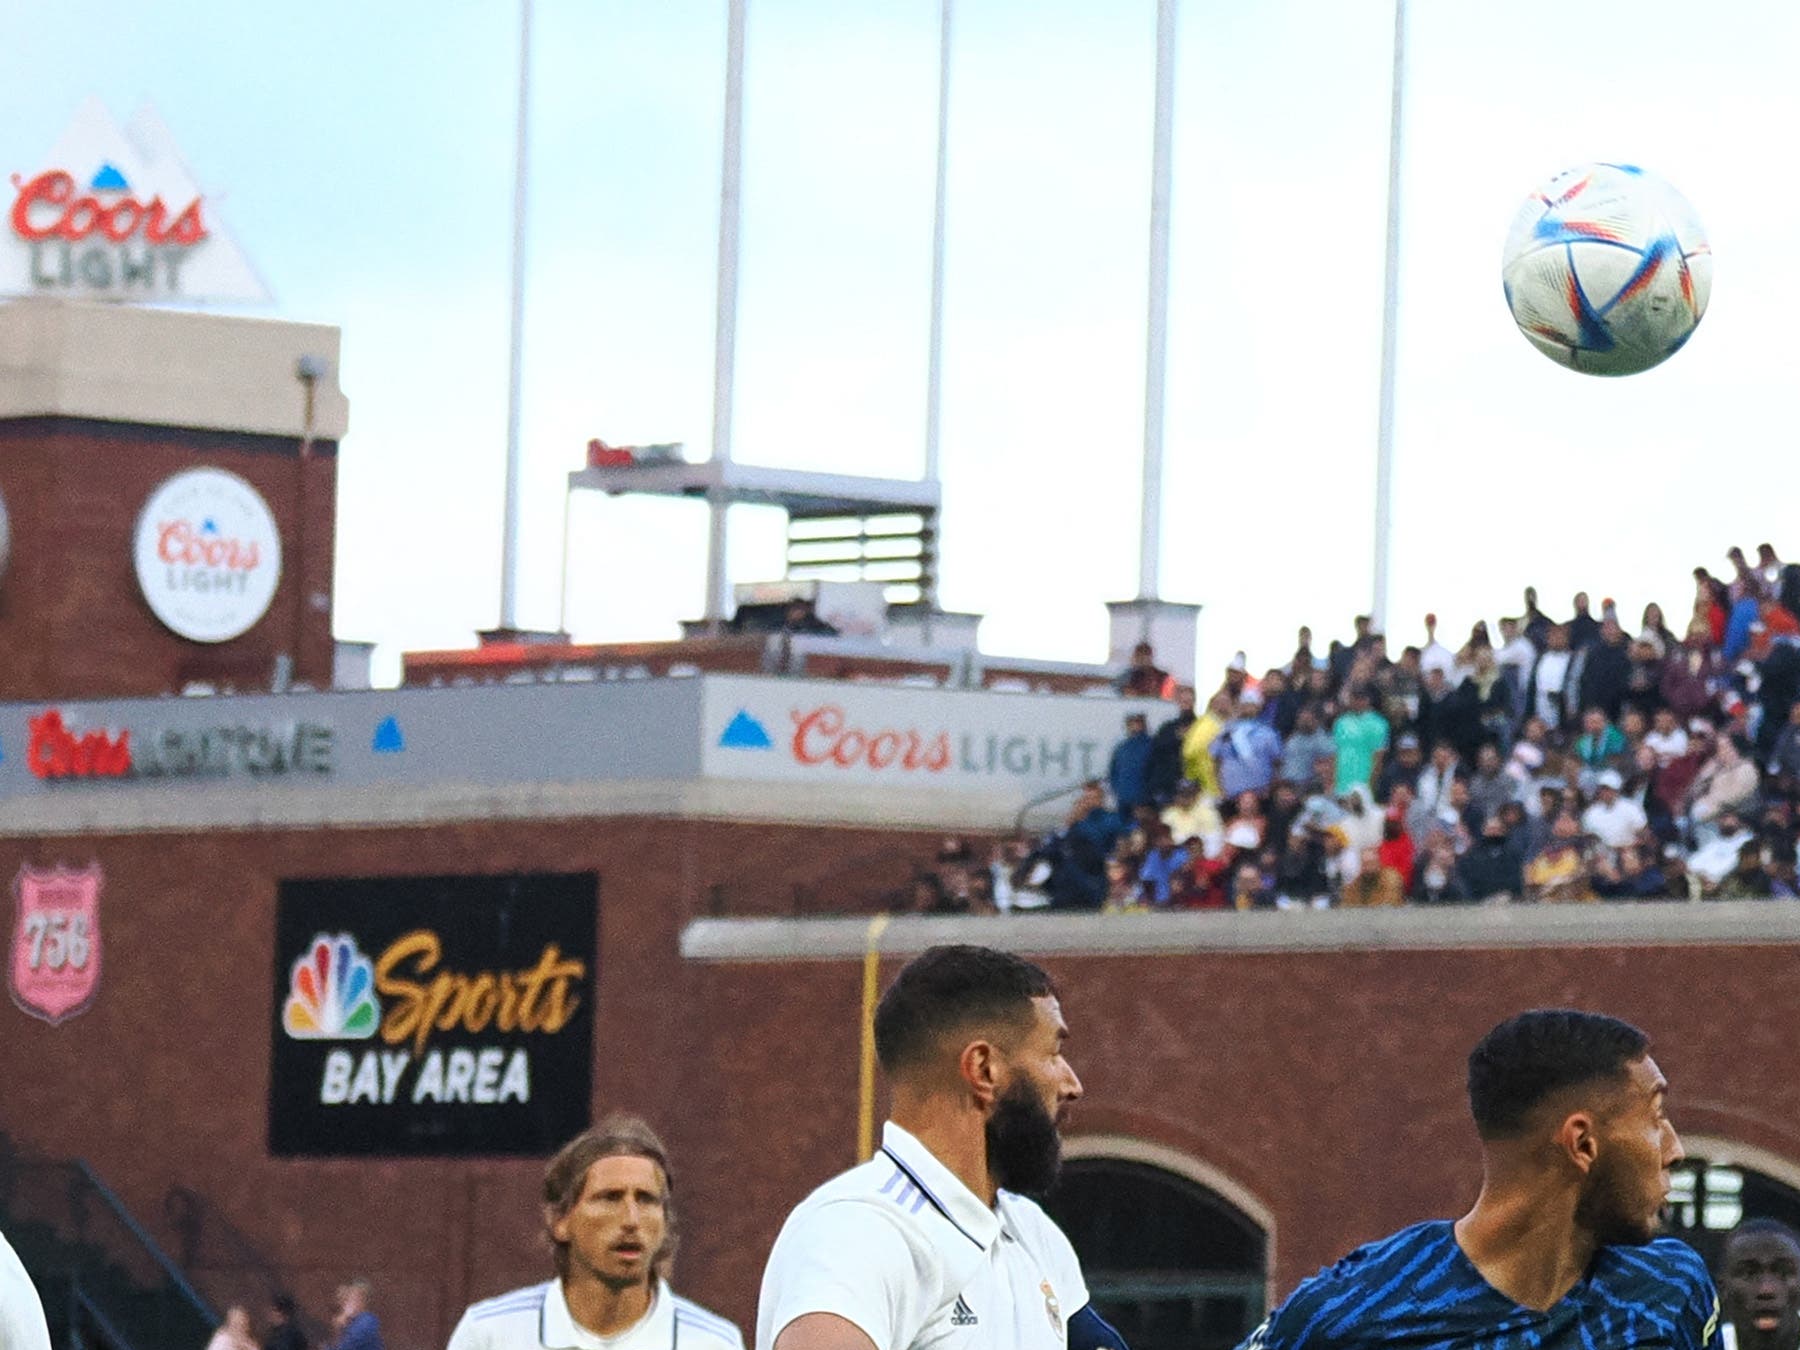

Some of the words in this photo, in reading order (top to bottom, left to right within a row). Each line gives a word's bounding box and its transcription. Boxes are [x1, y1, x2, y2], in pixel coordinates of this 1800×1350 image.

[10, 168, 208, 244] Coors
[28, 243, 189, 291] LIGHT
[157, 519, 261, 571] Coors
[789, 704, 952, 773] Coors
[957, 731, 1100, 778] LIGHT
[25, 912, 90, 969] 756
[375, 928, 586, 1059] Sports
[320, 1048, 410, 1105] BAY
[412, 1047, 531, 1105] AREA
